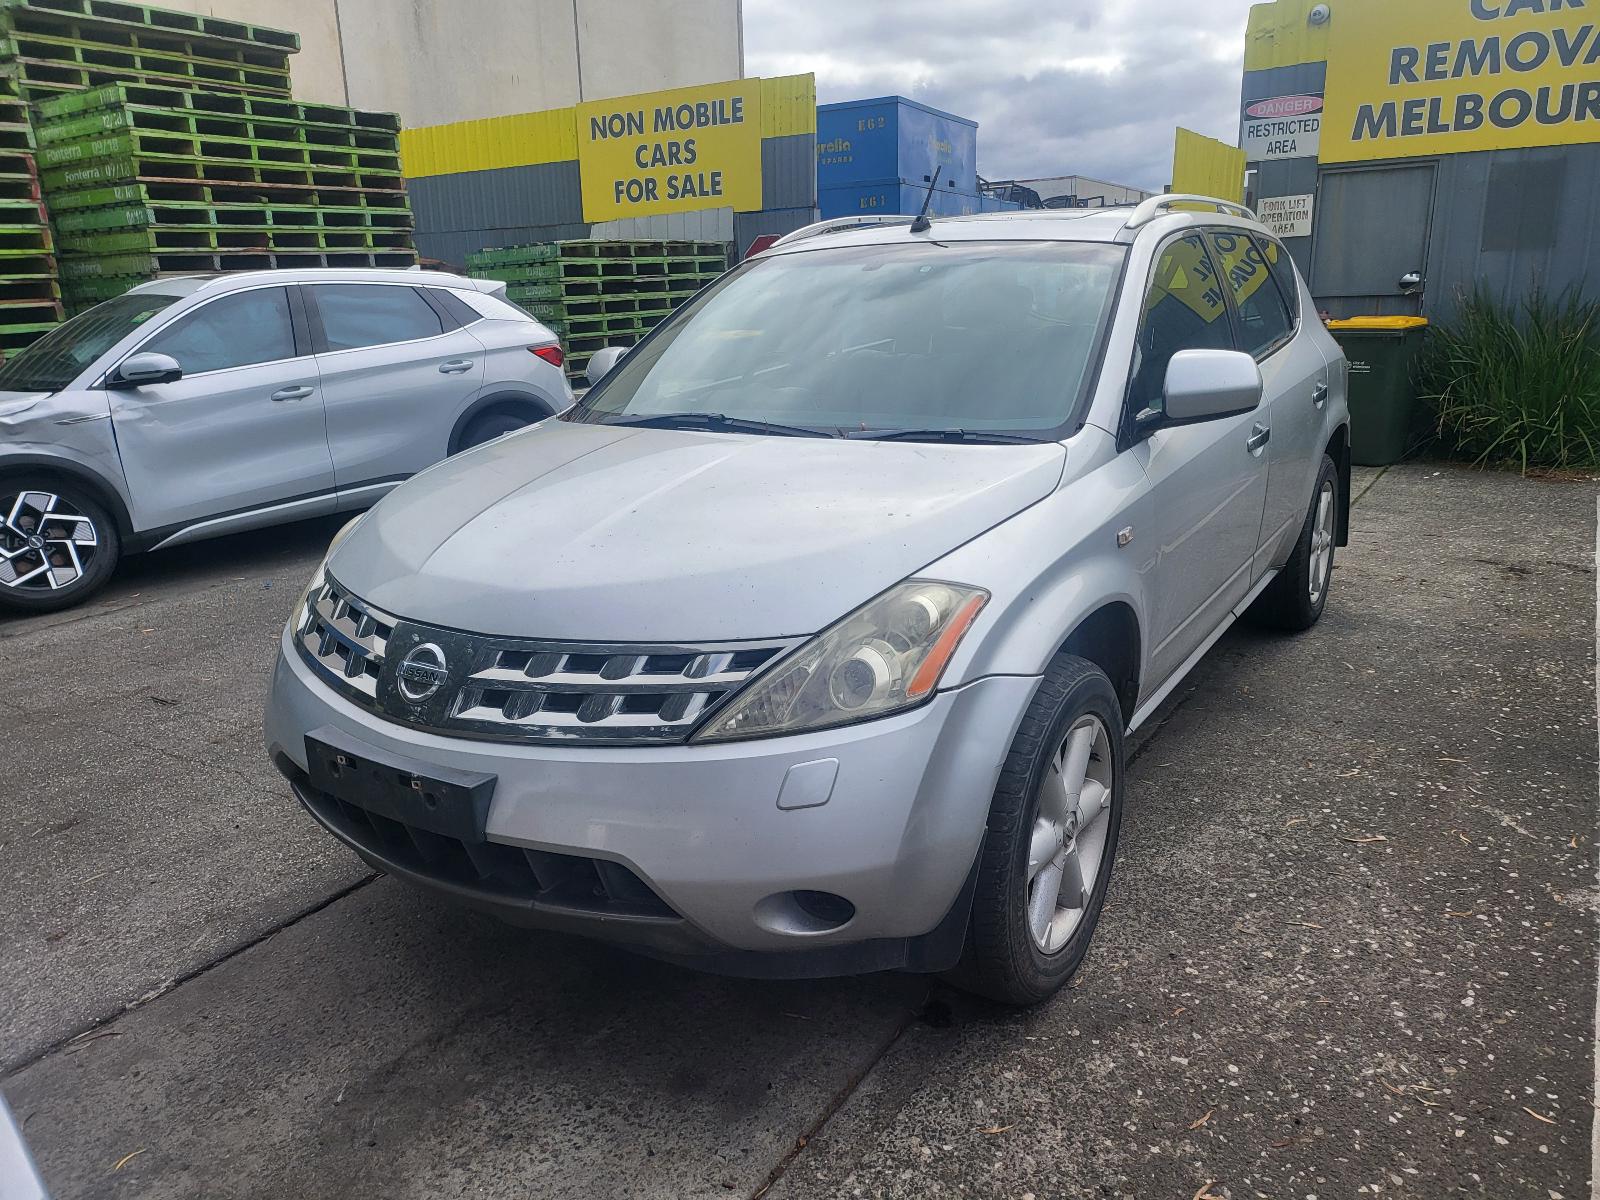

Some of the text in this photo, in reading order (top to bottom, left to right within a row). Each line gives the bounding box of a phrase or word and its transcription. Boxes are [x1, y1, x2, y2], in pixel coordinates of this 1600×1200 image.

[1470, 0, 1584, 20] CA
[1257, 100, 1313, 115] DANGER
[590, 97, 744, 140] NON MOBILE
[1248, 118, 1320, 139] RESTRICTED
[46, 145, 81, 161] Fonterra
[635, 139, 697, 169] CARS
[1266, 139, 1297, 155] AREA
[65, 167, 100, 182] Fonterra
[614, 171, 723, 204] FOR SALE
[1263, 199, 1306, 212] FORK LIFT
[1261, 210, 1309, 224] OPERATION
[1272, 223, 1295, 235] AREA
[400, 664, 439, 682] NISSAN
